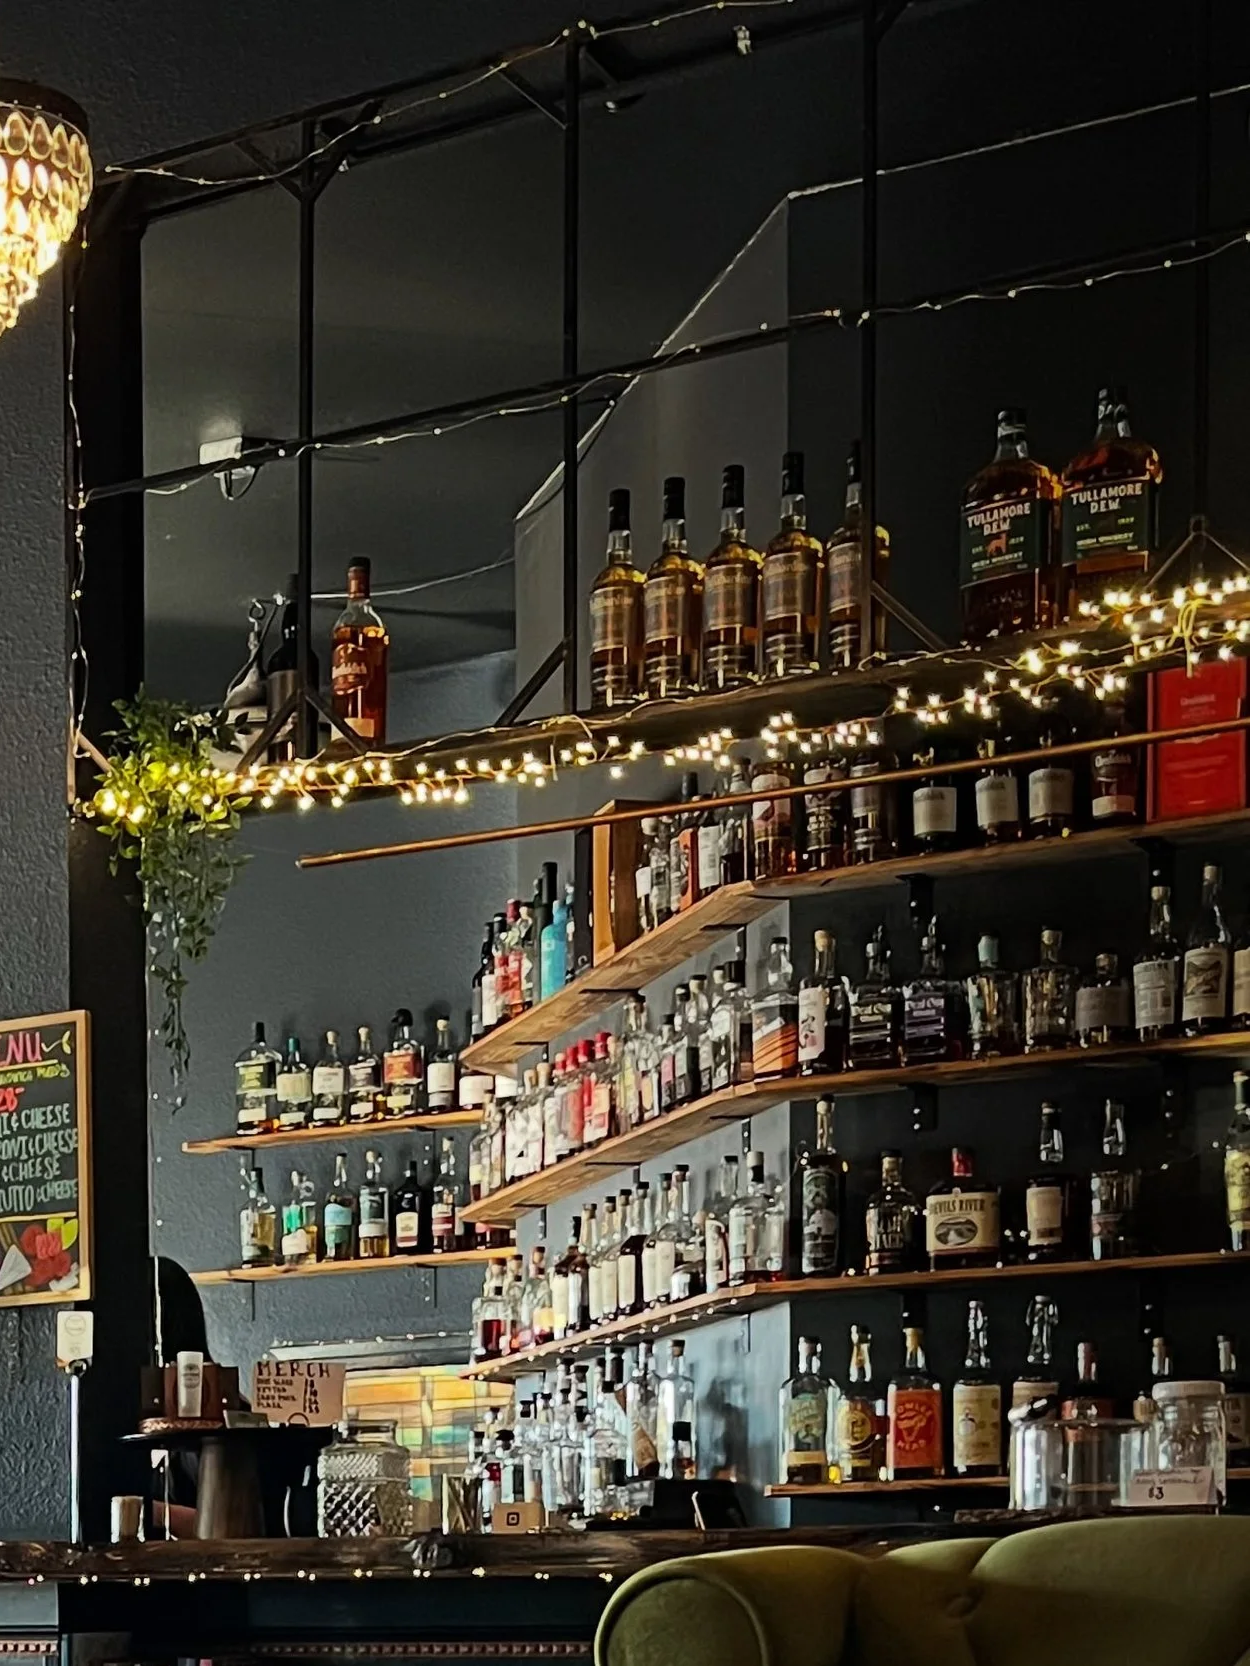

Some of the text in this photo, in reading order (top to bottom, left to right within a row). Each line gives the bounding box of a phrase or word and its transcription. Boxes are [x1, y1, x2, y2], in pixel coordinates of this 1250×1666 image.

[1071, 483, 1143, 505] TULLAMORE
[967, 502, 1031, 528] TULLAMORE
[21, 1103, 70, 1129] CHEESE
[34, 1128, 78, 1155] CHEESE
[10, 1155, 61, 1181] CHEESE
[41, 1179, 78, 1203] CHEESE
[257, 1360, 330, 1378] MERCH
